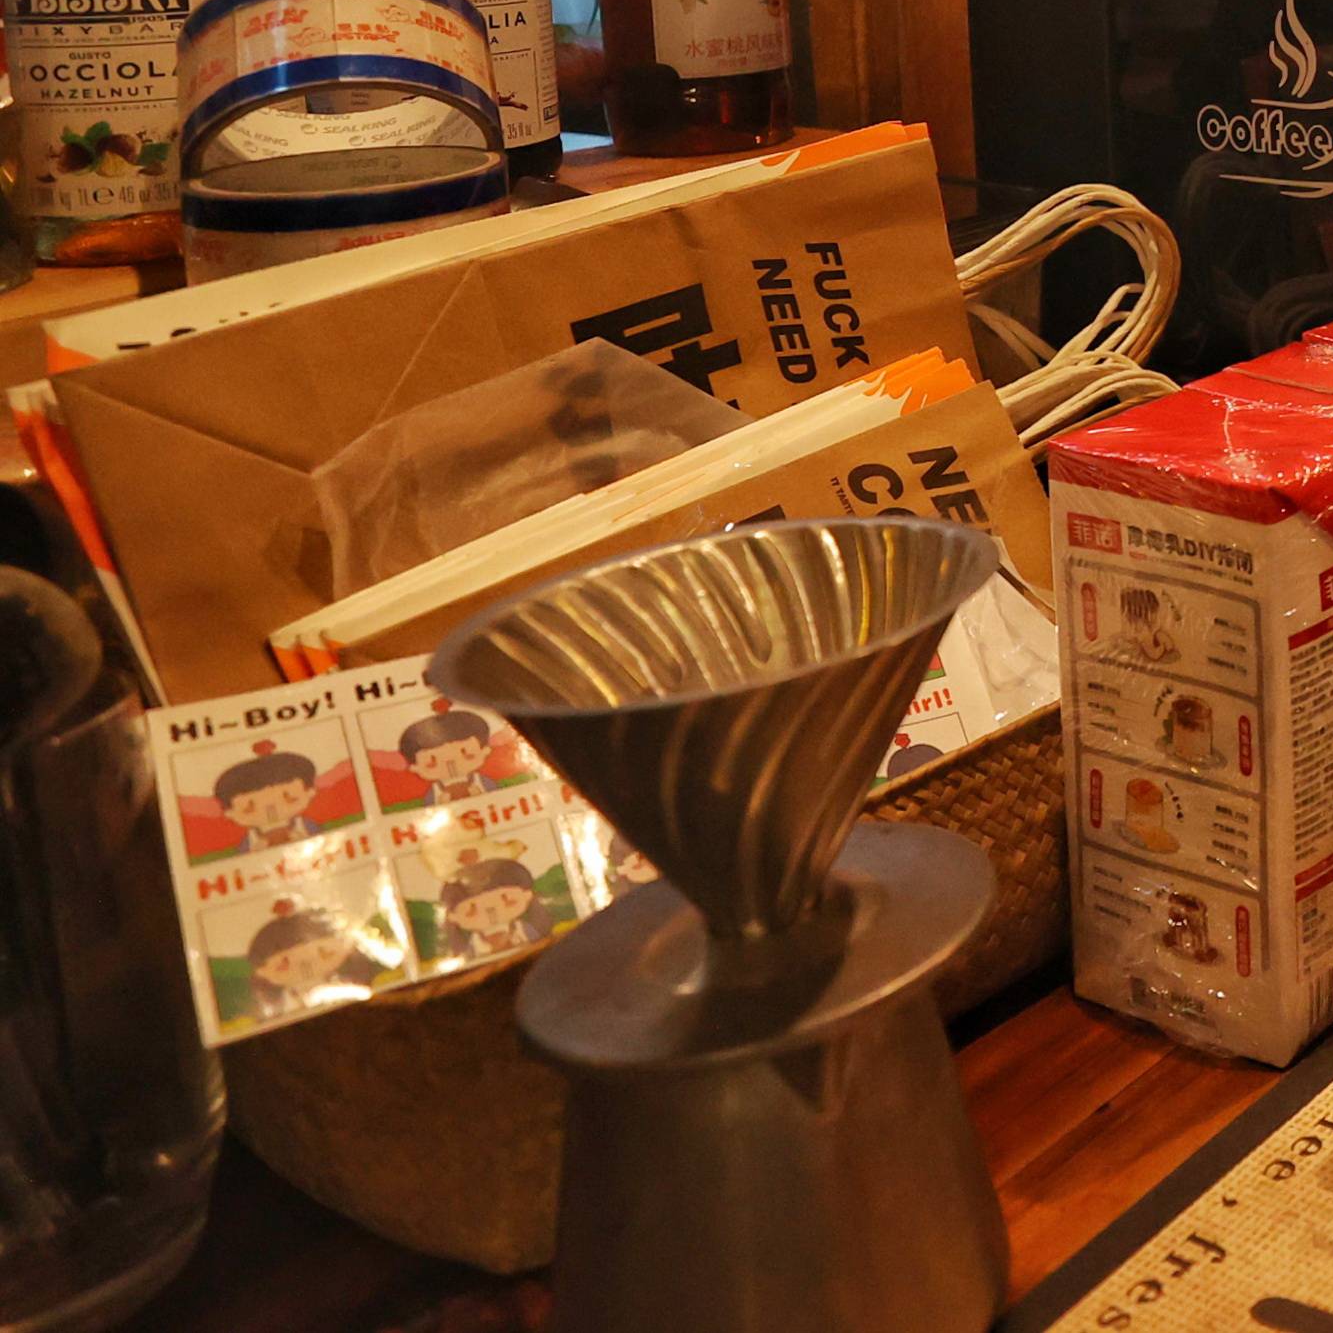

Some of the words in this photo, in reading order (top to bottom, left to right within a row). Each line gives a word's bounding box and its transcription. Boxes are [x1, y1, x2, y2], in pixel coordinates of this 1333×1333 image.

[24, 61, 177, 82] OCCIOL
[68, 52, 111, 60] GUSTO
[40, 85, 154, 99] HAZELNUT
[1197, 104, 1333, 161] Coffee
[751, 257, 818, 385] NEED
[805, 241, 871, 369] FUCK
[907, 445, 993, 535] NE
[1072, 519, 1114, 547] 菲诺
[906, 687, 953, 716] irl!
[1098, 1230, 1228, 1332] fres
